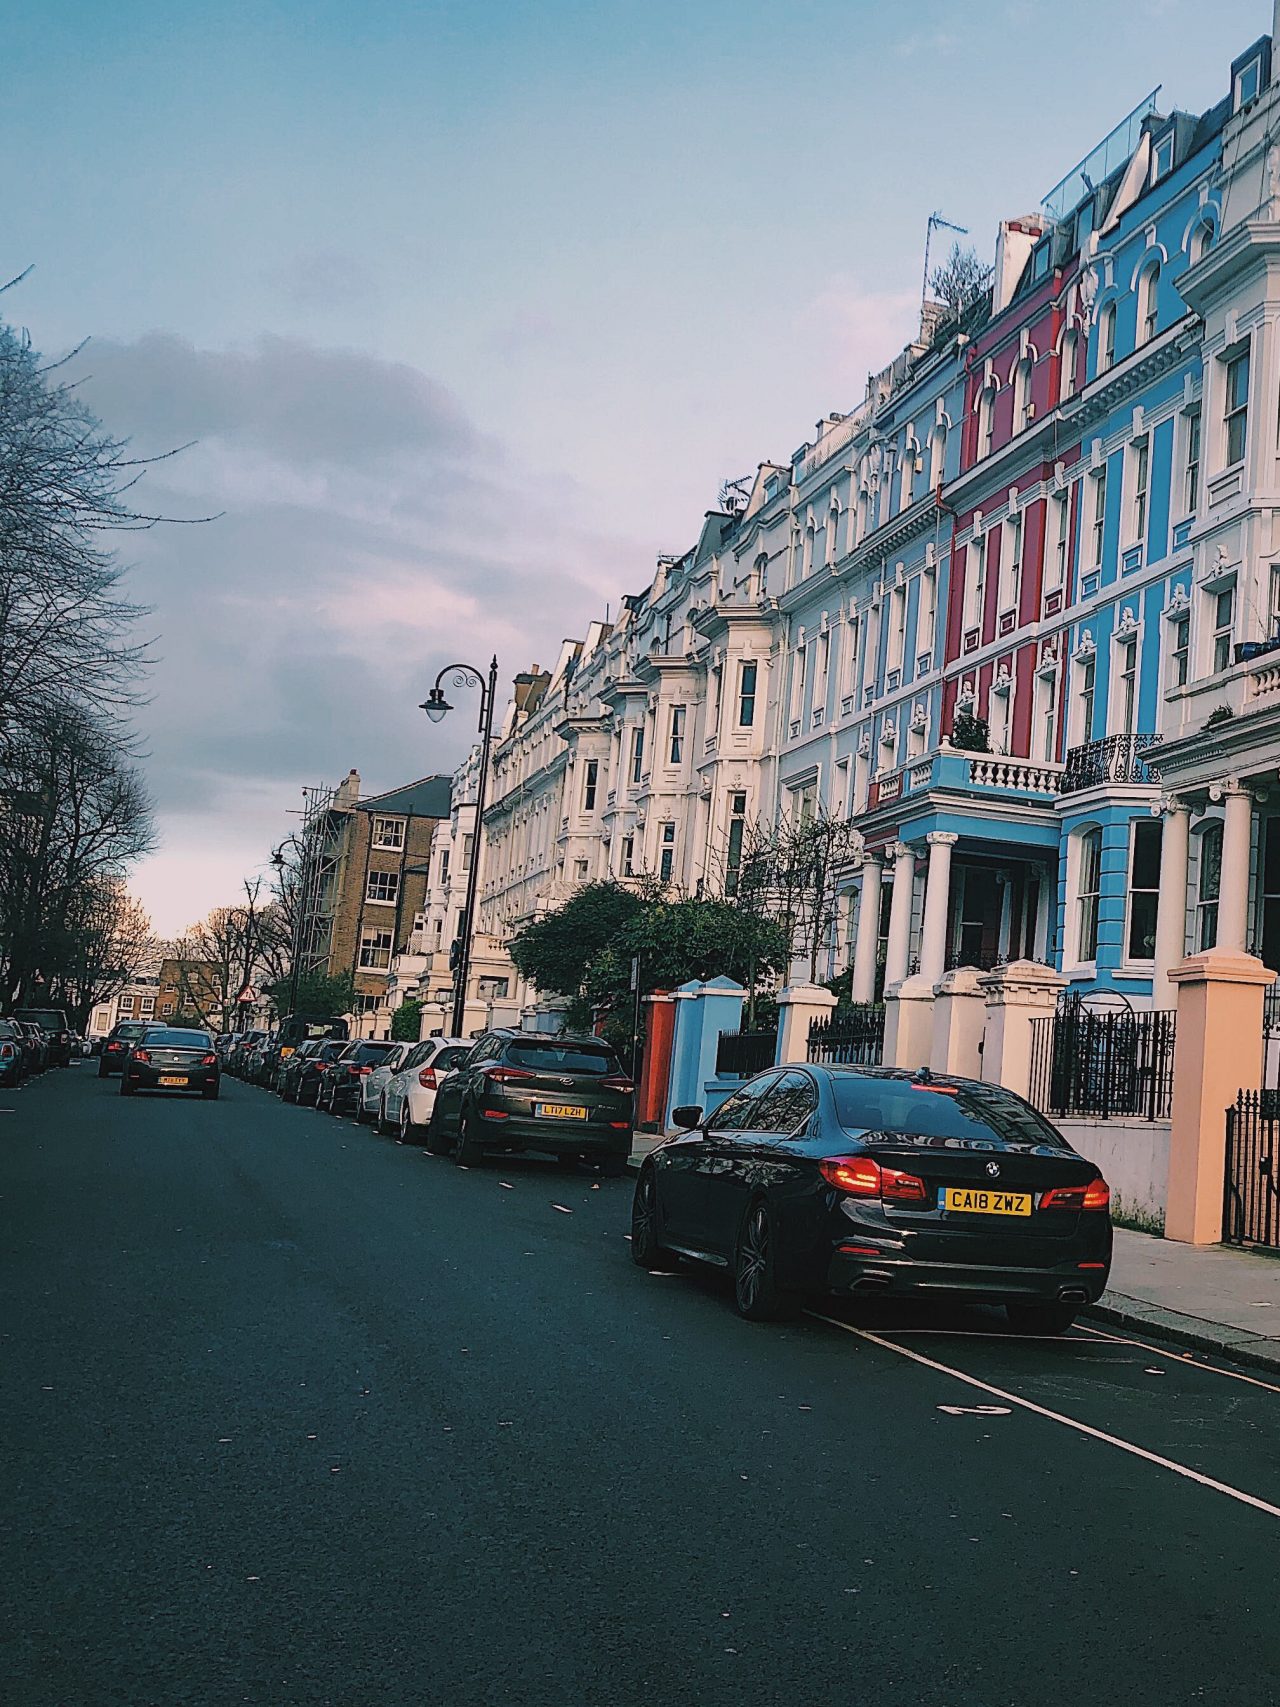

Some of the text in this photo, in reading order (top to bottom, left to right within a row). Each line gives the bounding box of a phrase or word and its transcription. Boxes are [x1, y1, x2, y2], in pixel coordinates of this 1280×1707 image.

[543, 1105, 581, 1116] LT17 LZH
[951, 1191, 1025, 1212] CA18 ZWZ
